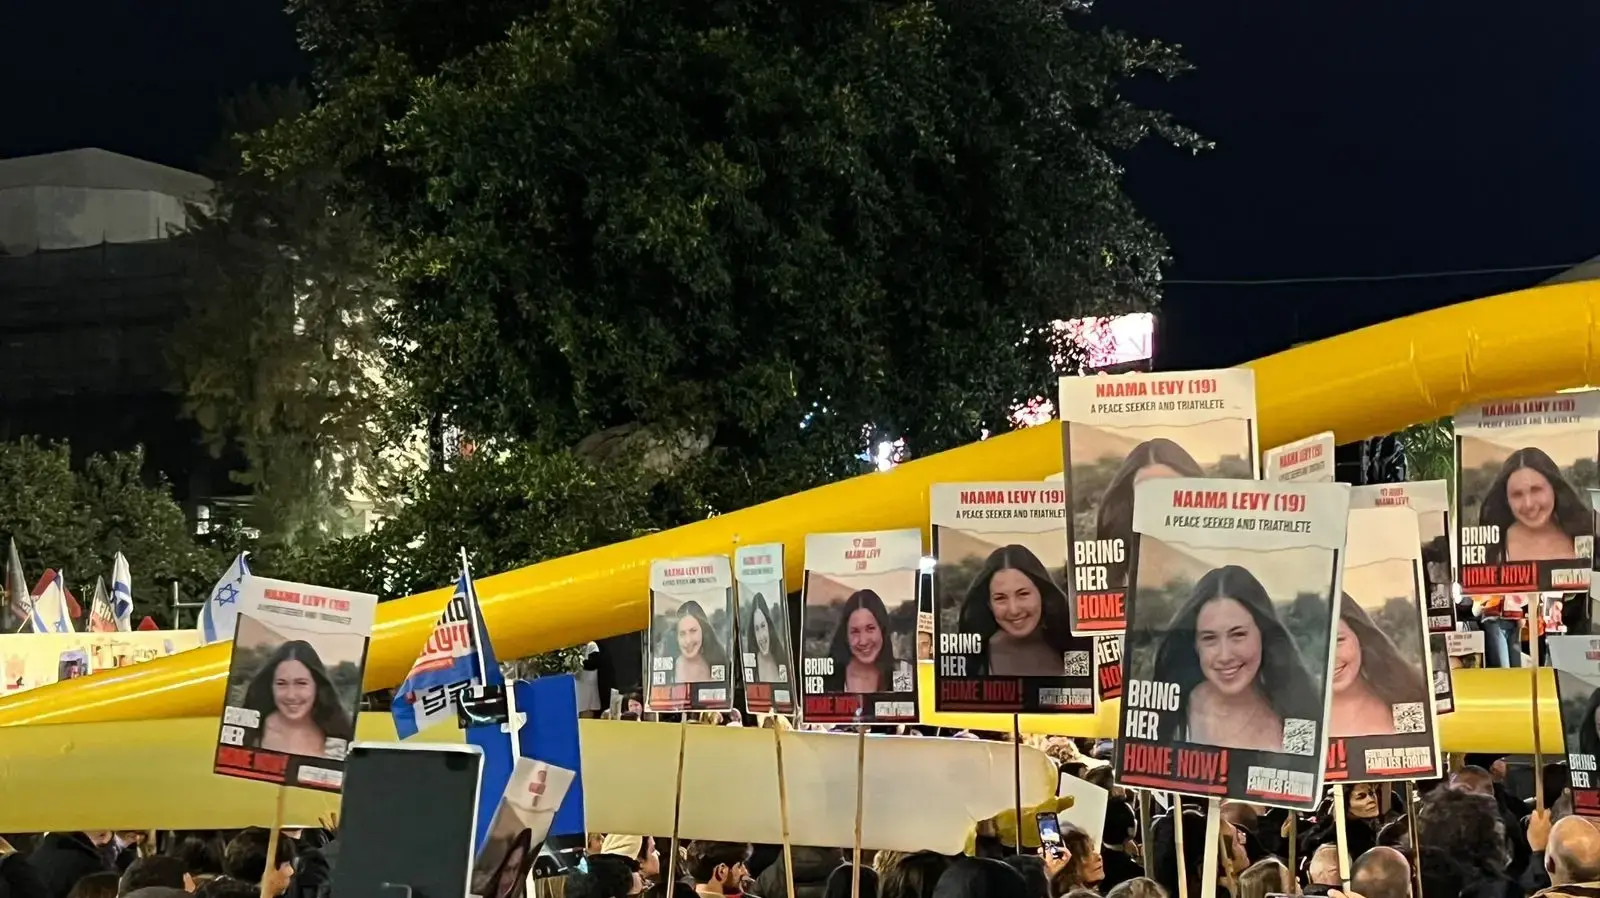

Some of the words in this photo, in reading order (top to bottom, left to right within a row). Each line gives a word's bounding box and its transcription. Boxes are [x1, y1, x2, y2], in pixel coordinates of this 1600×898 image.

[1096, 382, 1147, 398] NAAMA
[1151, 379, 1184, 395] LEVY
[1188, 378, 1217, 394] (19)
[1091, 404, 1096, 413] A
[1098, 402, 1123, 413] PEACE
[1125, 401, 1156, 412] SEEKER
[1158, 401, 1174, 411] AND
[1177, 399, 1224, 411] TRIATHLETE
[960, 491, 1005, 504] NAAMA
[1008, 490, 1036, 504] LEVY
[1040, 490, 1064, 503] (19)
[1173, 490, 1227, 509] NAAMA
[1231, 492, 1271, 511] LEVY
[1274, 494, 1306, 512] (19)
[956, 510, 960, 519] A
[962, 510, 983, 518] PEACE
[985, 509, 1011, 518] SEEKER
[1014, 509, 1028, 518] AND
[1030, 509, 1066, 518] TRIATHLET
[1165, 516, 1171, 527] A
[1173, 516, 1200, 528] PEACE
[1202, 517, 1235, 529] SEEKER
[1236, 518, 1255, 530] AND
[1258, 519, 1312, 533] TRIATHLETE
[1462, 525, 1500, 545] BRING
[1074, 538, 1125, 566] BRING
[1462, 545, 1486, 565] HER
[1075, 566, 1108, 591] HER
[1077, 592, 1125, 620] HOME
[940, 633, 982, 654] BRING
[1098, 639, 1120, 664] HER
[804, 657, 834, 676] BRING
[941, 655, 967, 676] HER
[805, 676, 825, 694] HER
[1100, 665, 1121, 690] HO
[941, 680, 980, 701] HOME
[983, 678, 1023, 703] NOW!
[1128, 679, 1181, 711] BRING
[1126, 709, 1159, 741] HER
[1123, 743, 1172, 775] HOME
[1177, 747, 1228, 784] NOW!
[1569, 753, 1597, 771] BRING
[1571, 771, 1591, 788] HER
